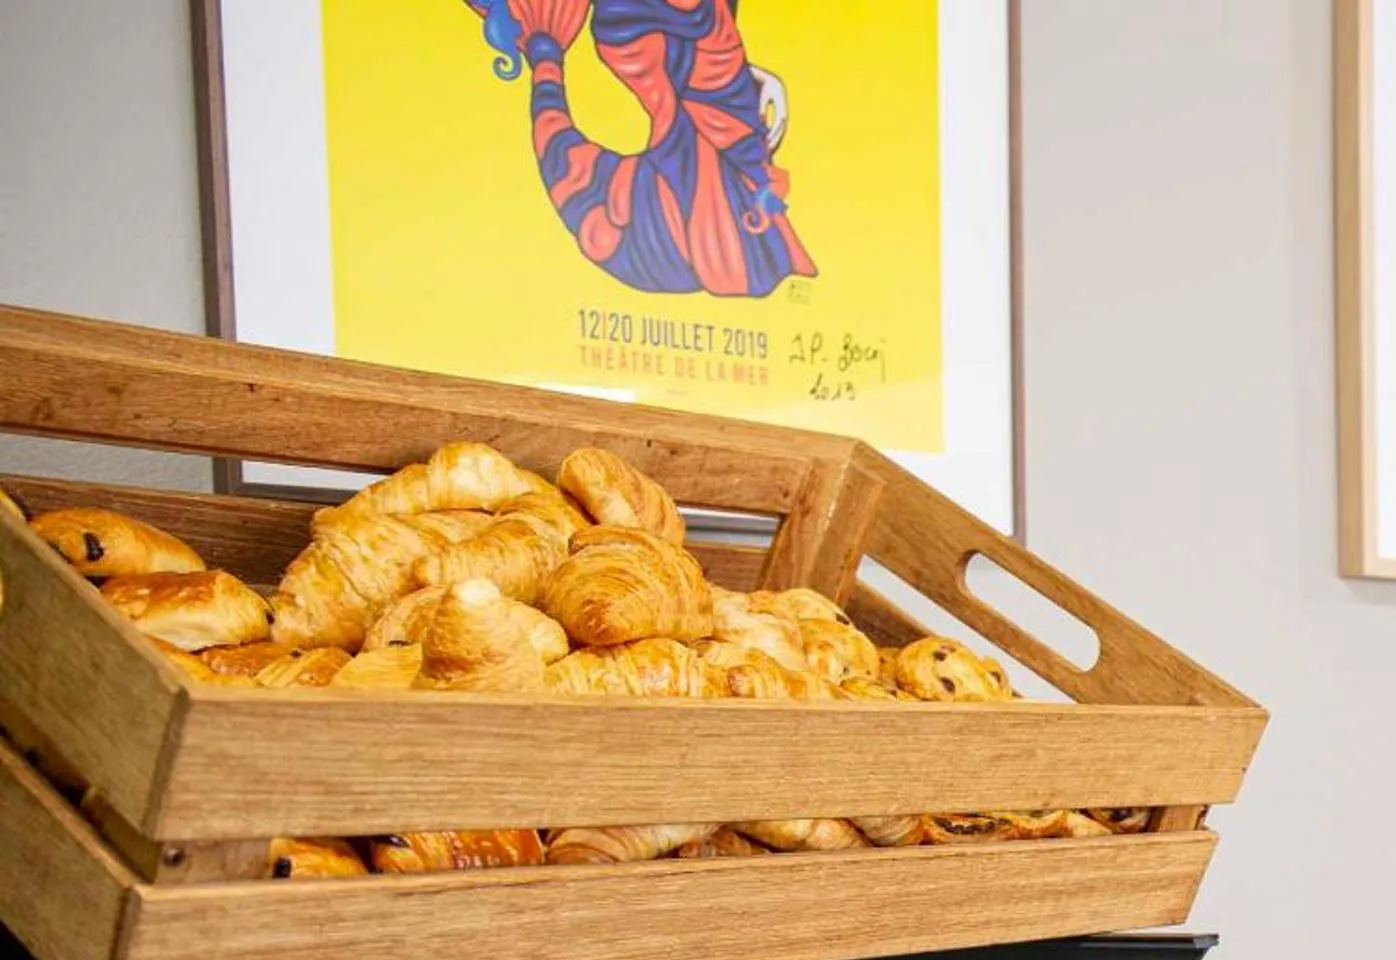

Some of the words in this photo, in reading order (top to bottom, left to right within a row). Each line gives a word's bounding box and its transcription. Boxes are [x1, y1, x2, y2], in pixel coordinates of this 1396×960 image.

[640, 317, 715, 353] JUILLET
[723, 328, 768, 359] 2019
[674, 356, 697, 379] DE
[706, 361, 726, 382] LA
[732, 361, 769, 386] MER
